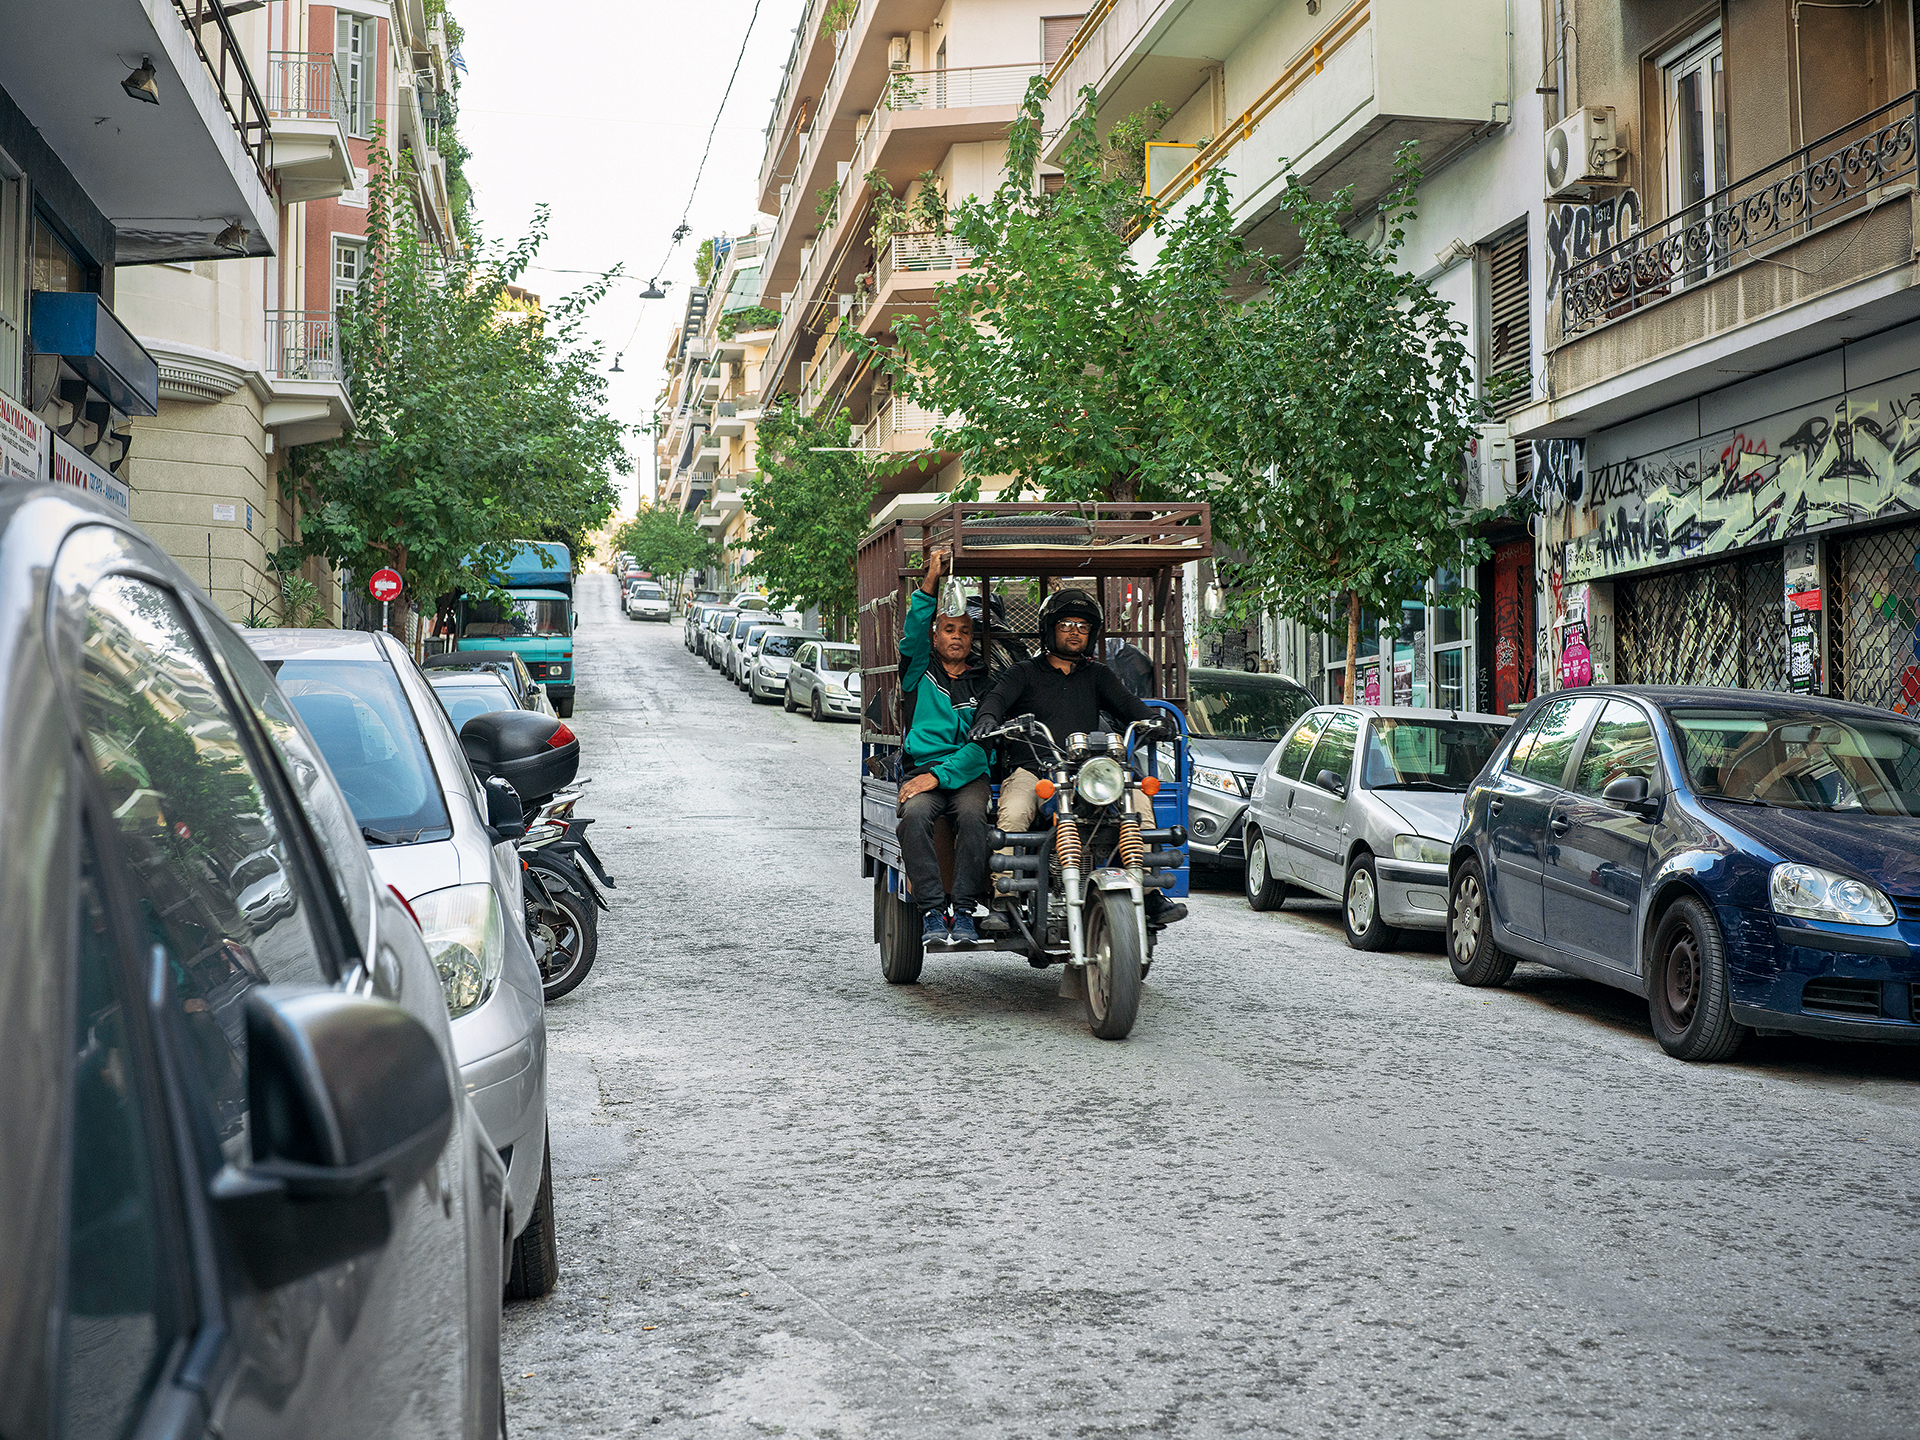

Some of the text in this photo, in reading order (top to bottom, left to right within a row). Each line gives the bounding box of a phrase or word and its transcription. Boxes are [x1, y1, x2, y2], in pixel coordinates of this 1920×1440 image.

[1471, 459, 1478, 470] LG
[1564, 624, 1585, 639] ANTIFA
[1566, 634, 1585, 650] LIVE
